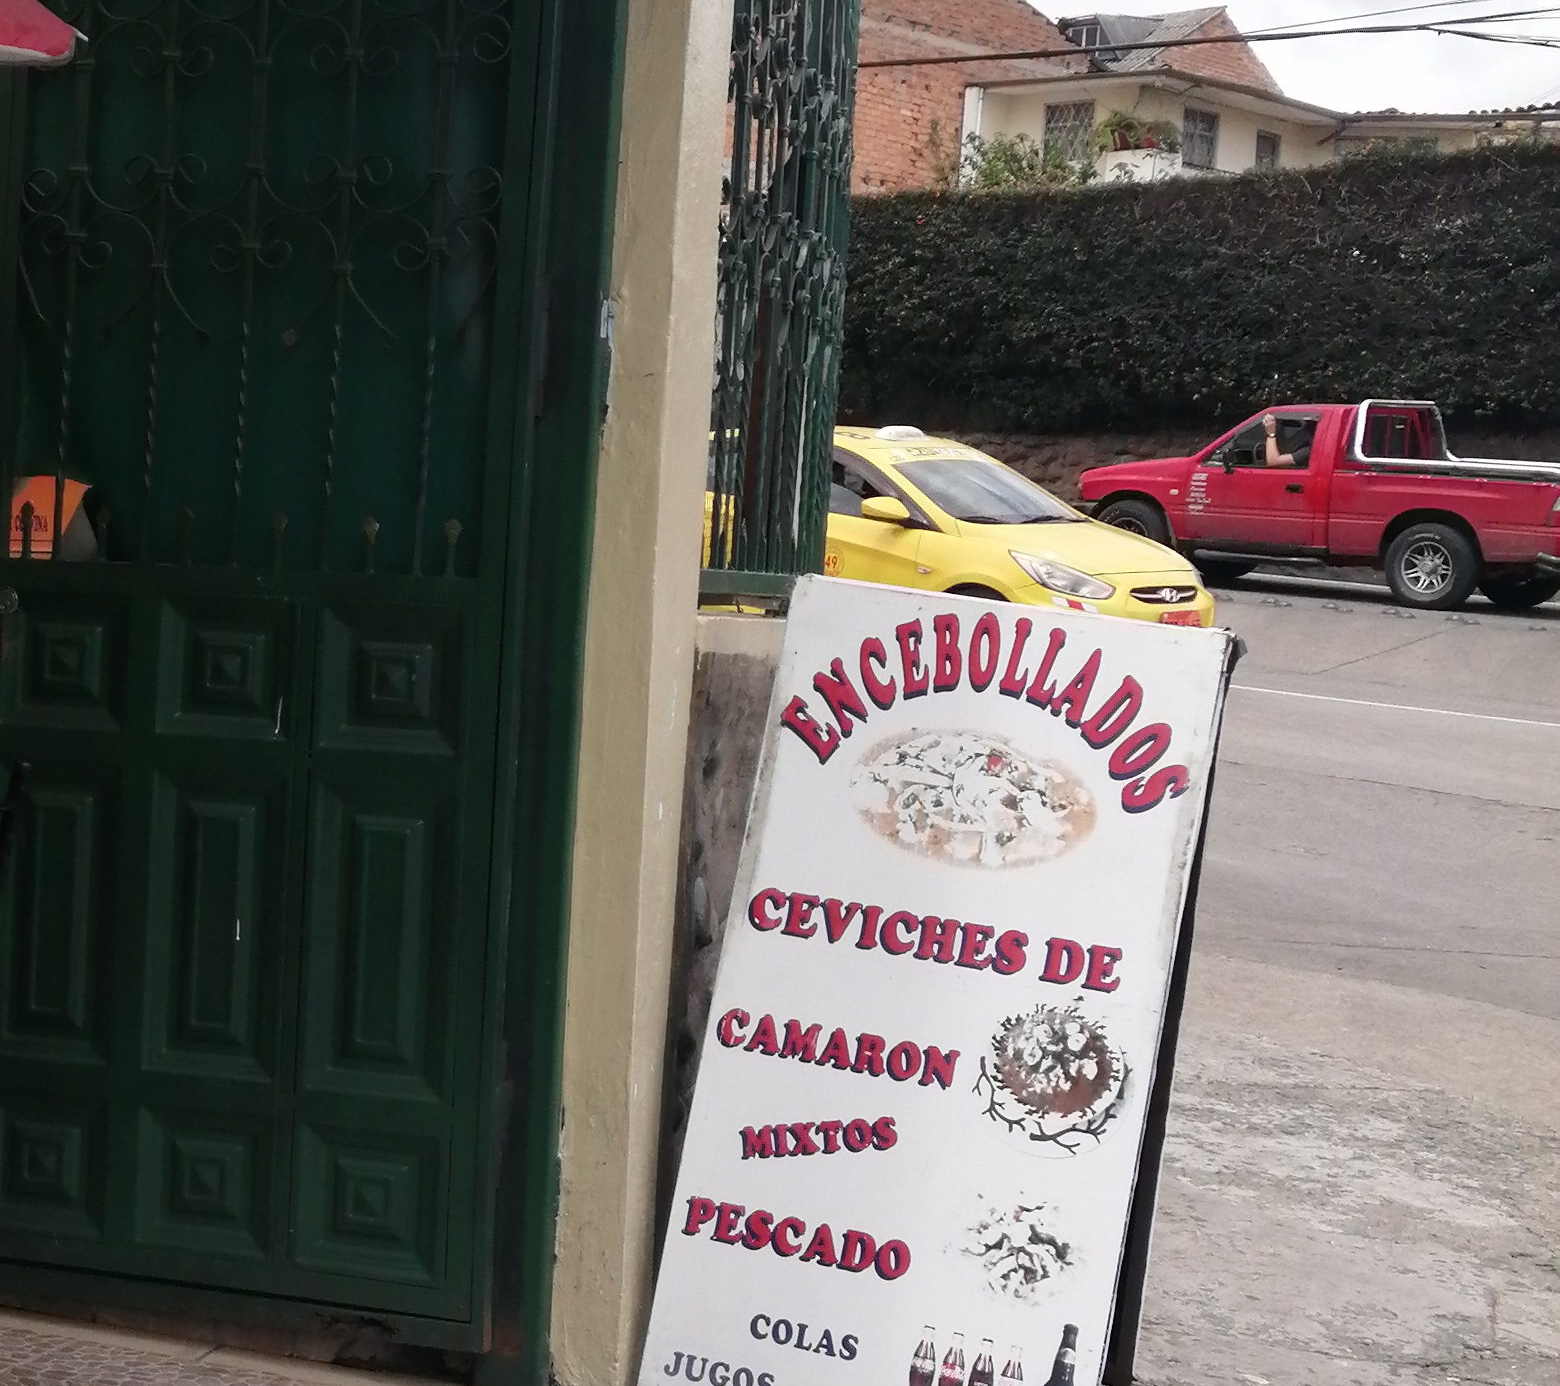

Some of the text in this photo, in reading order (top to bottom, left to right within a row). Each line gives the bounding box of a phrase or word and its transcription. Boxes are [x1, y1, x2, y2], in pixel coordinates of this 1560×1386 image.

[781, 612, 1190, 814] ENCEBOLLADOS
[748, 888, 1123, 994] CEVICHES DE
[716, 1008, 961, 1090] CAMARON
[739, 1116, 898, 1160] MIXTOS
[681, 1195, 912, 1281] PESCADO
[749, 1313, 859, 1361] COLAS
